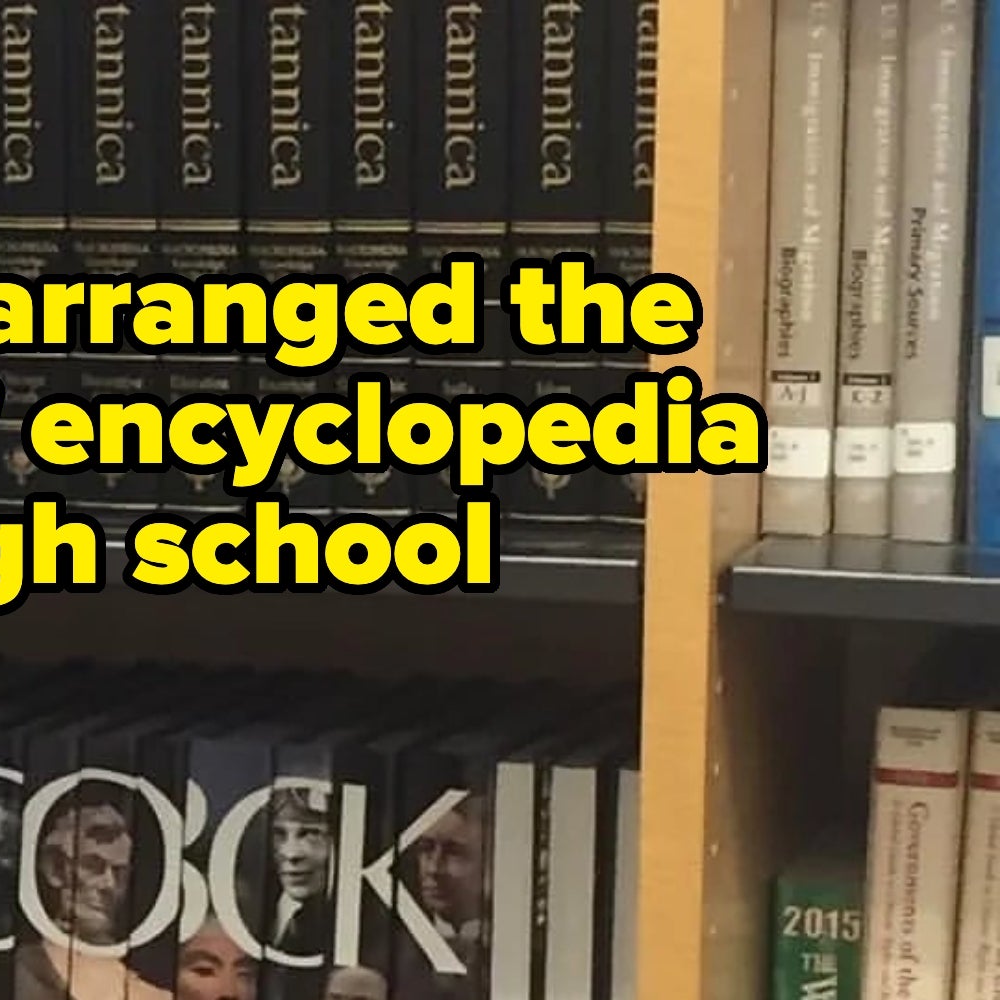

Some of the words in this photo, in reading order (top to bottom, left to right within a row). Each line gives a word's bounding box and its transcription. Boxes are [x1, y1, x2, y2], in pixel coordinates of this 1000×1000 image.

[908, 206, 928, 277] Primary
[772, 246, 798, 359] Biographies
[846, 250, 868, 361] Biographies
[904, 288, 925, 360] Sources
[899, 800, 930, 936] Governments
[782, 904, 863, 943] 2015
[898, 940, 921, 966] of
[895, 966, 921, 998] the
